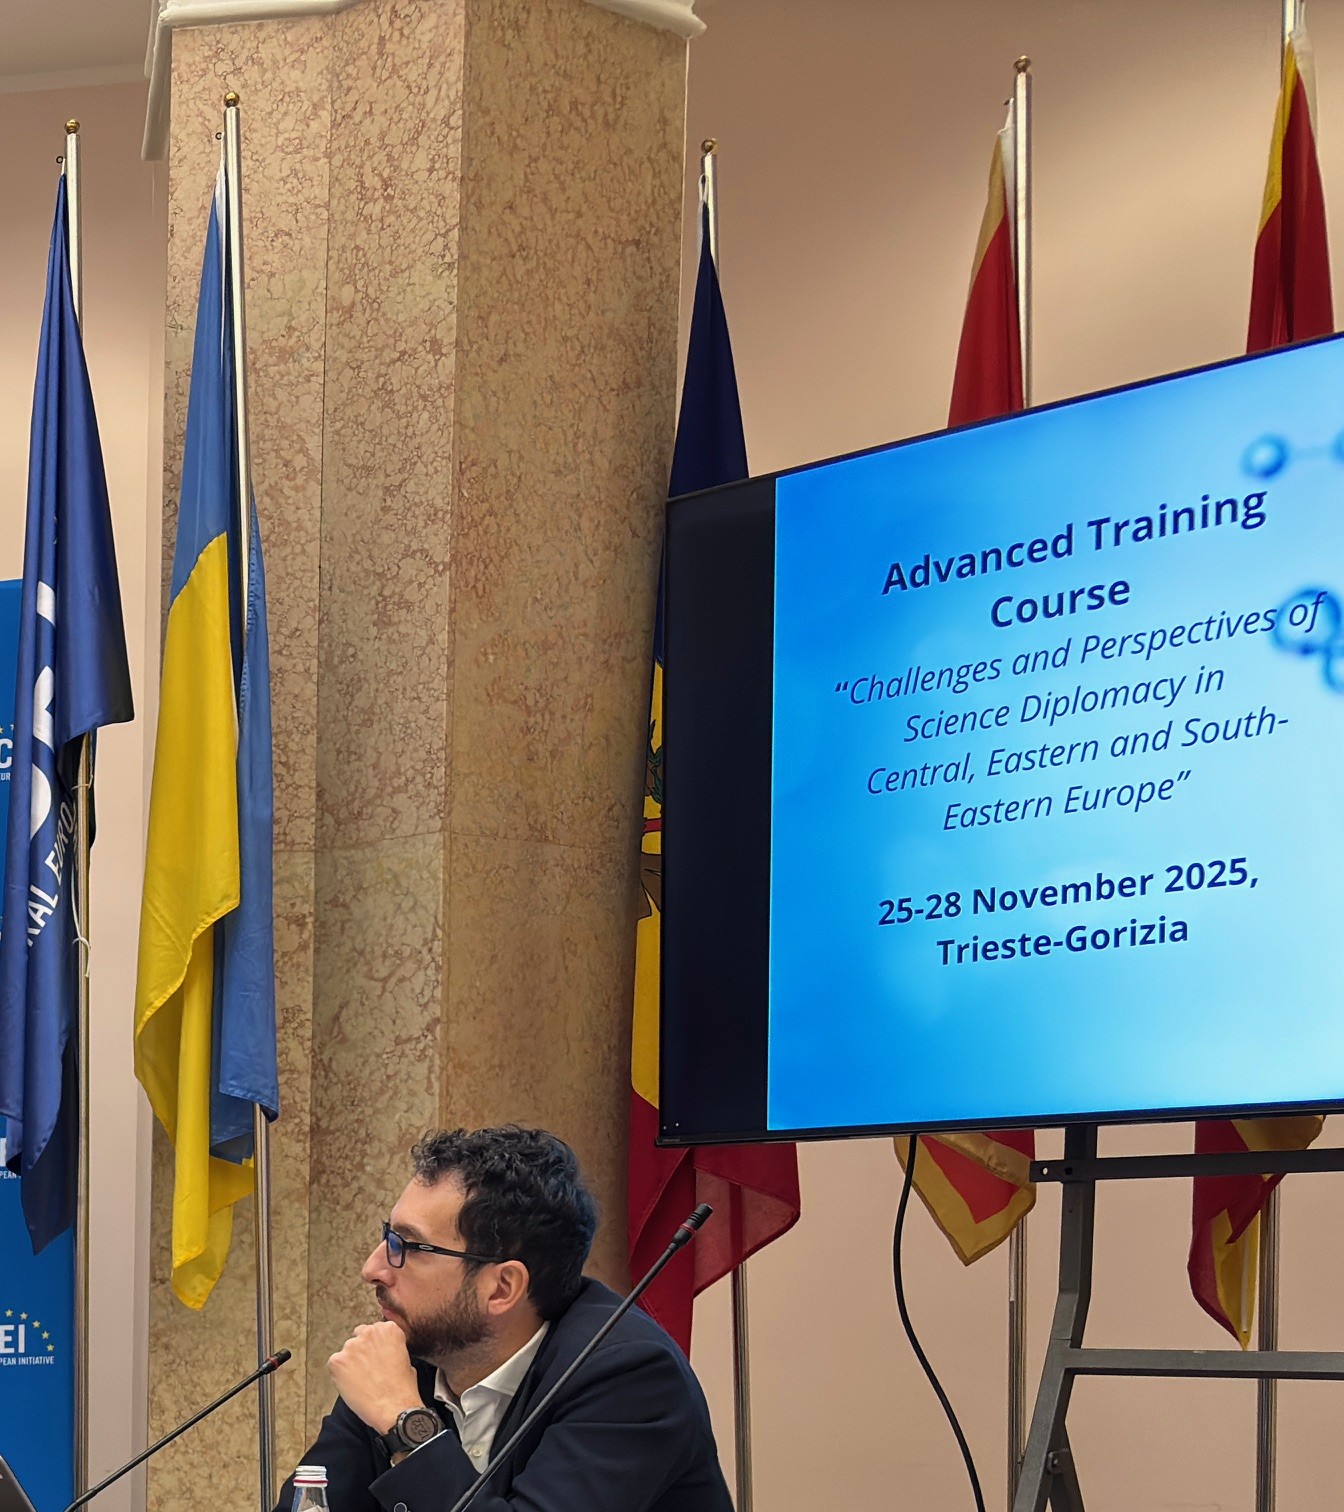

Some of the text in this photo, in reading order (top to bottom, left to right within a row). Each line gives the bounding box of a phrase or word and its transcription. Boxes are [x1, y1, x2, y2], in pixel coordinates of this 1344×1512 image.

[881, 491, 1268, 595] Advanced Training
[991, 580, 1130, 628] Course
[1012, 637, 1072, 675] and
[1081, 607, 1277, 664] Perspectives
[1288, 591, 1328, 631] of
[903, 665, 1224, 742] Science Diplomacy in
[867, 706, 1289, 796] Central, Eastern and South-
[943, 796, 1052, 830] Eastern
[878, 857, 1258, 926] 25-28 November 2025,
[936, 915, 1188, 965] Trieste-Gorizia
[18, 1355, 54, 1365] INITIATIVE
